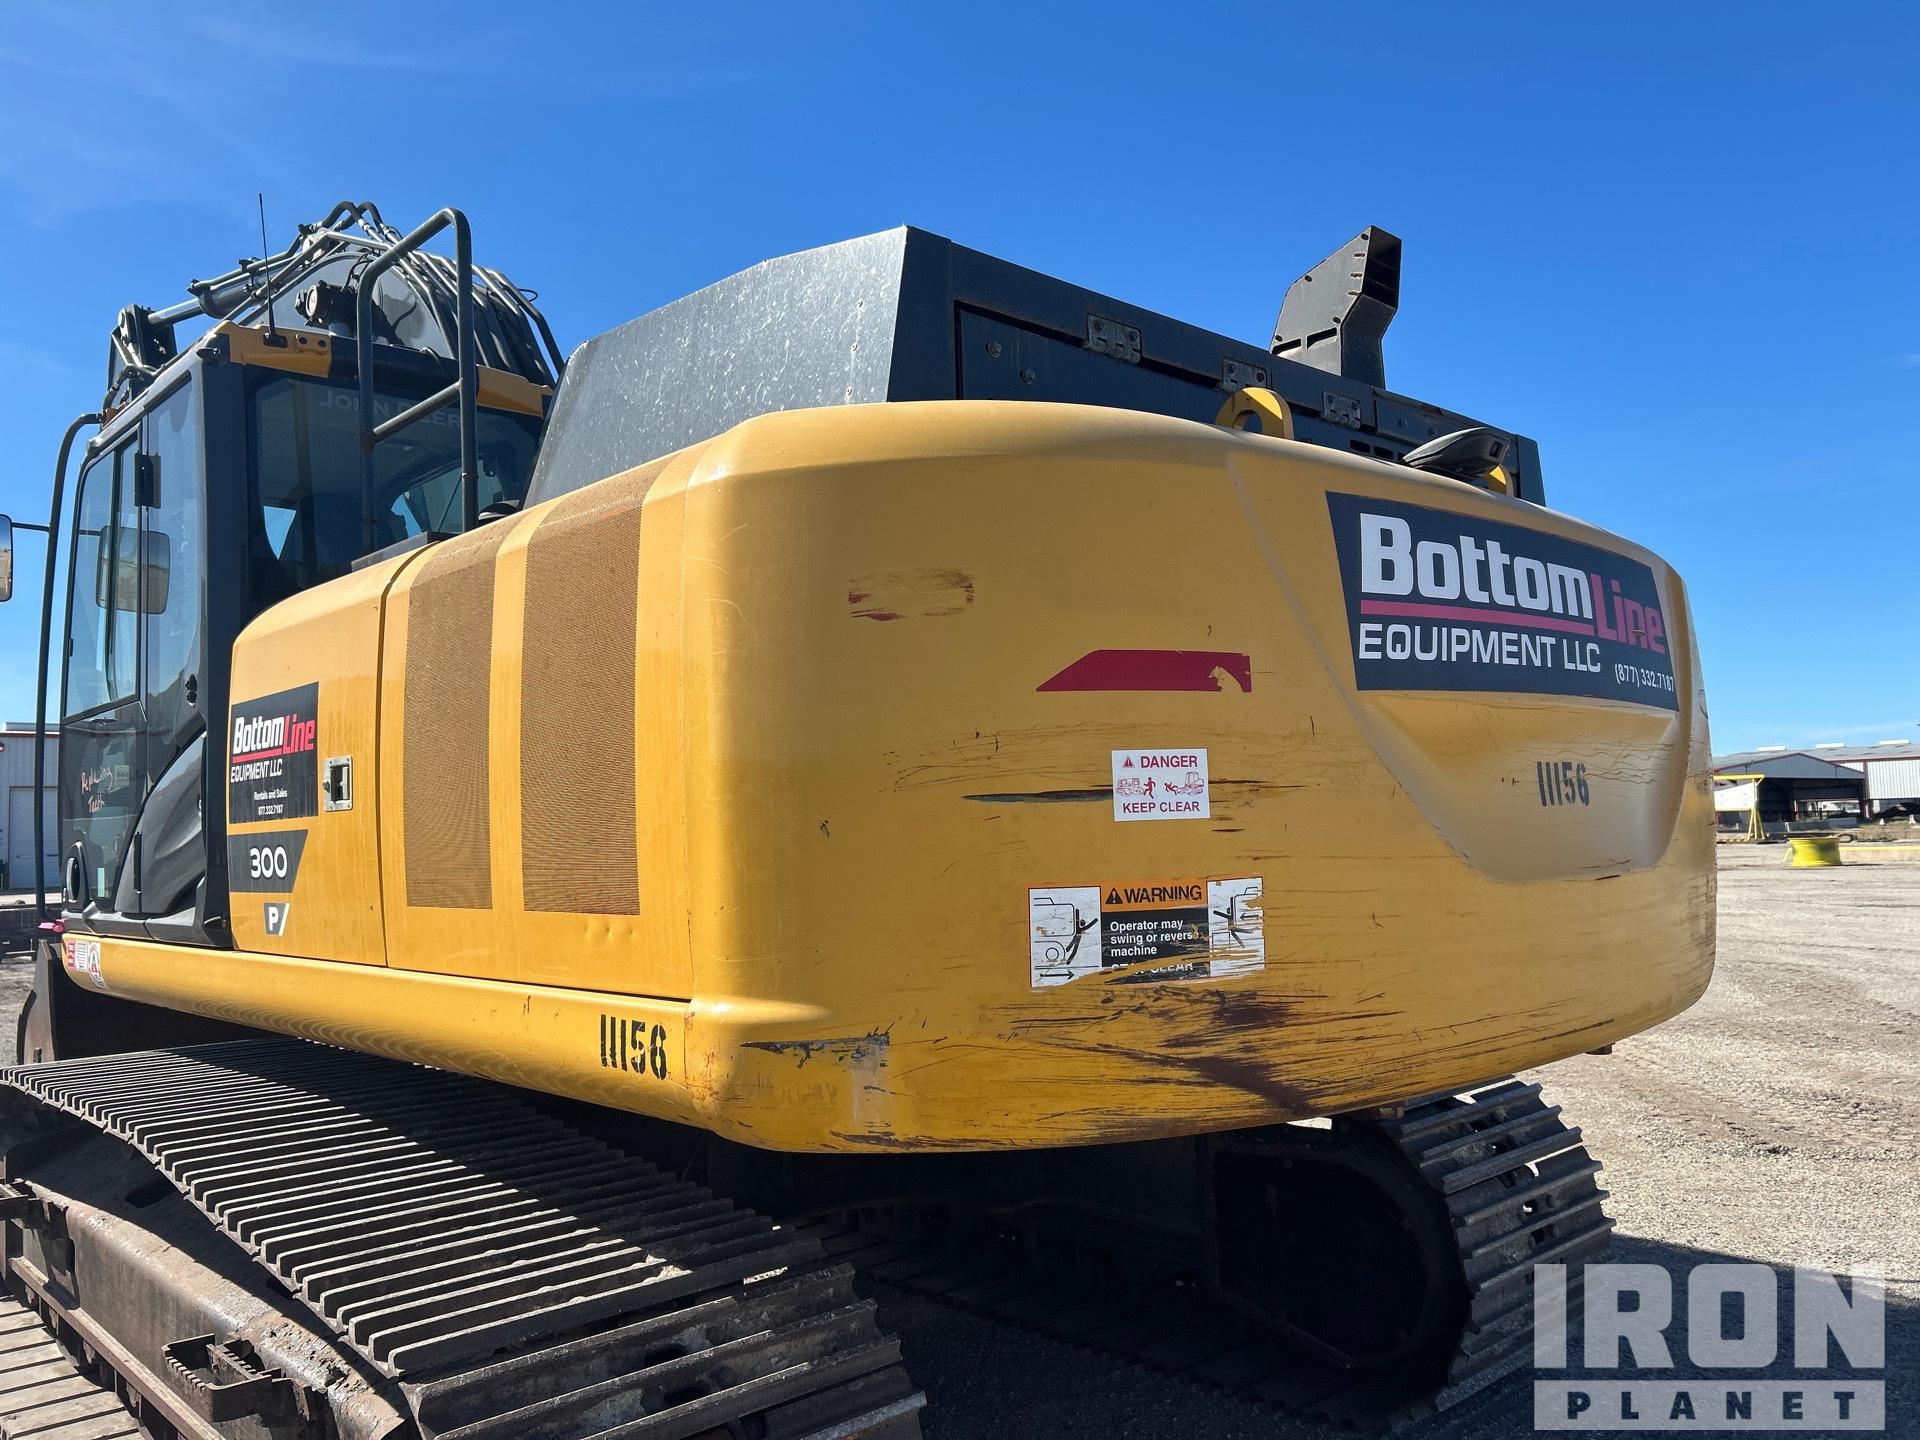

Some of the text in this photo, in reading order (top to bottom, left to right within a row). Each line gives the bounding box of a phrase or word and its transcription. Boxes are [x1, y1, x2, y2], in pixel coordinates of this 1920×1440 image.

[1360, 512, 1666, 655] BottomLine
[1359, 623, 1675, 693] EQUIPMENT LLC (877) 332.7187
[234, 714, 315, 754] BottomLine
[231, 758, 283, 782] EQUIPMENT LLC
[1140, 755, 1198, 769] DANGER
[276, 788, 288, 799] Sales
[1537, 761, 1590, 807] 11156
[1122, 801, 1200, 814] KEEP CLEAR
[250, 846, 288, 879] 300
[1124, 885, 1203, 904] WARNING
[1110, 919, 1183, 933] Operator may
[1110, 934, 1143, 946] swing
[1146, 934, 1157, 943] or
[1111, 945, 1157, 957] machine
